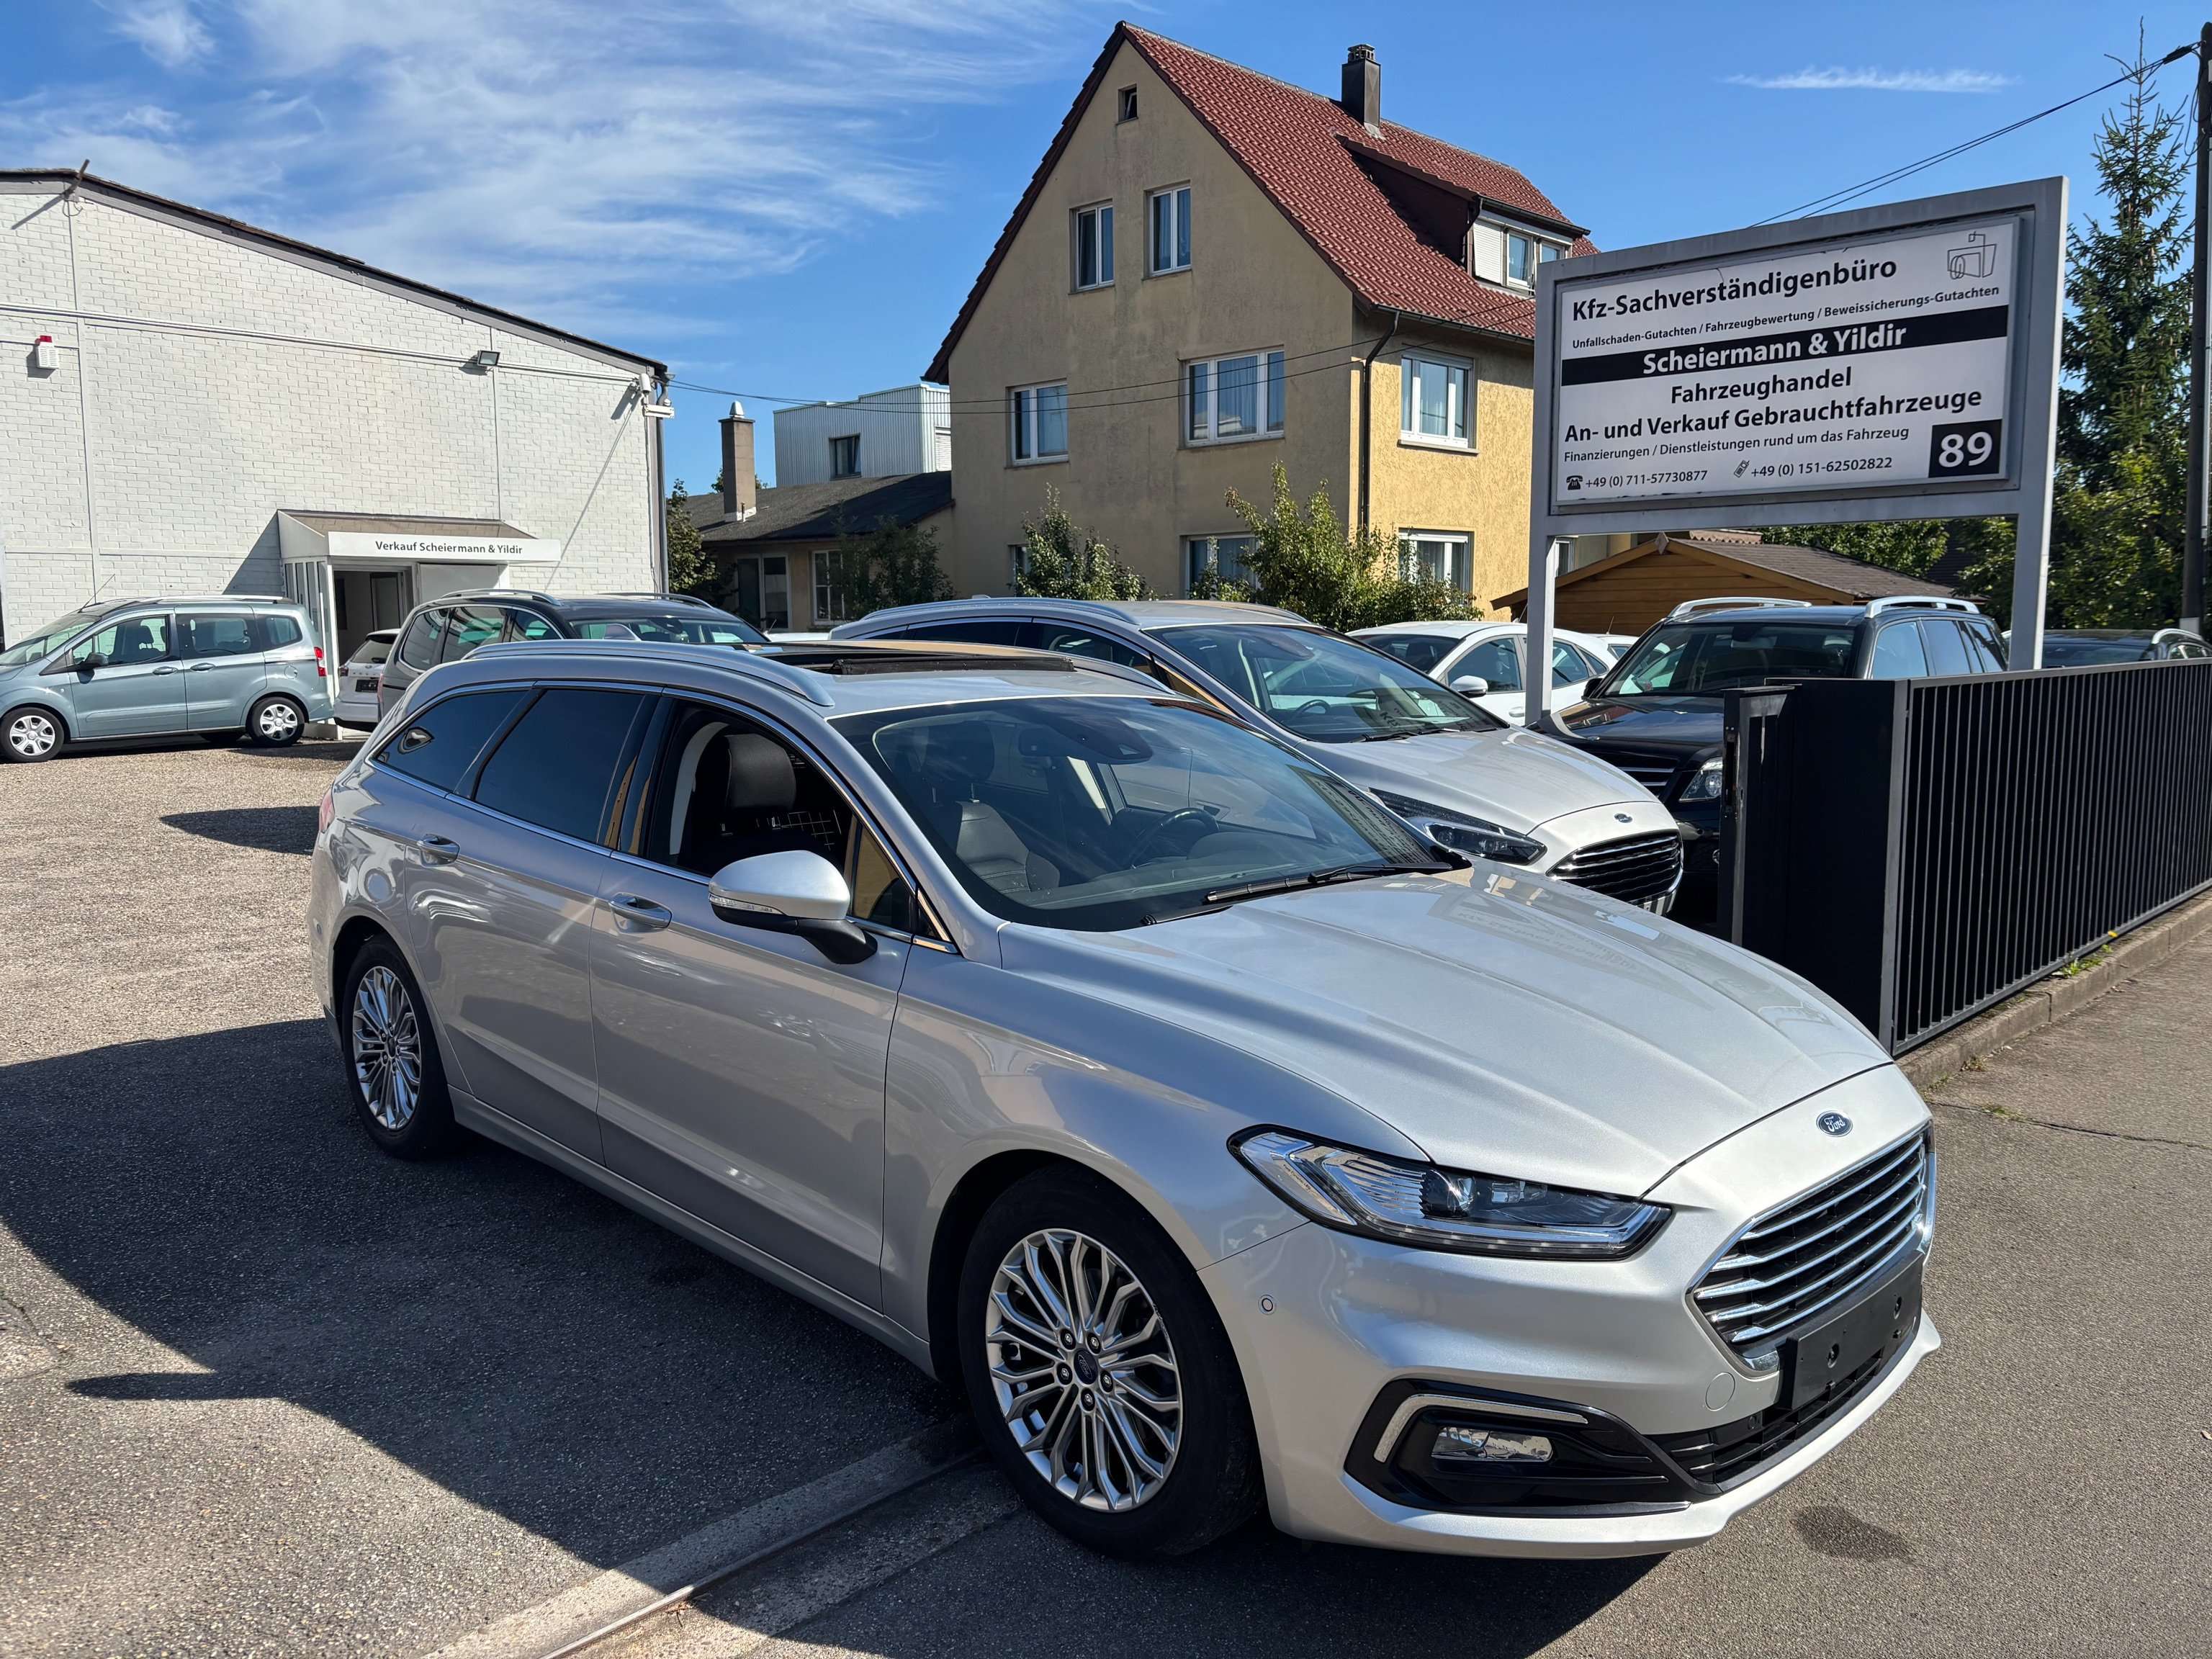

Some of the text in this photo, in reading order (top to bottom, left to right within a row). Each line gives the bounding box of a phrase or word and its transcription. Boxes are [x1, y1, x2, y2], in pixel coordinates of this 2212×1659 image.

[1573, 258, 1897, 321] Kfz-Sachverständigenbüro
[1572, 326, 1697, 349] Unfallschaden-Gutachten
[1705, 310, 1815, 333] Fahrzeugbewertung
[1824, 287, 2000, 317] Beweissicherungs-Gutachten
[1643, 323, 1907, 374] Scheiermann & Yildir
[1671, 366, 1852, 404] Fahrzeughandel
[1565, 391, 1982, 442] An- und Verkauf Gebrauchtfahrzeuge
[1564, 446, 1650, 462] Finanzierungen
[1660, 439, 1761, 455] Dienstleistungen
[1763, 433, 1794, 446] rund
[1797, 435, 1817, 444] um
[1821, 430, 1843, 442] das
[1847, 427, 1910, 441] Fahrzeug
[1938, 431, 1993, 468] 89
[1586, 470, 1708, 488] +49 (0) 711-57730877
[1751, 457, 1892, 477] +49 (0) 151-62502822
[375, 541, 523, 554] Verkauf Scheiermann & Yildir
[1824, 1115, 1845, 1133] Ford
